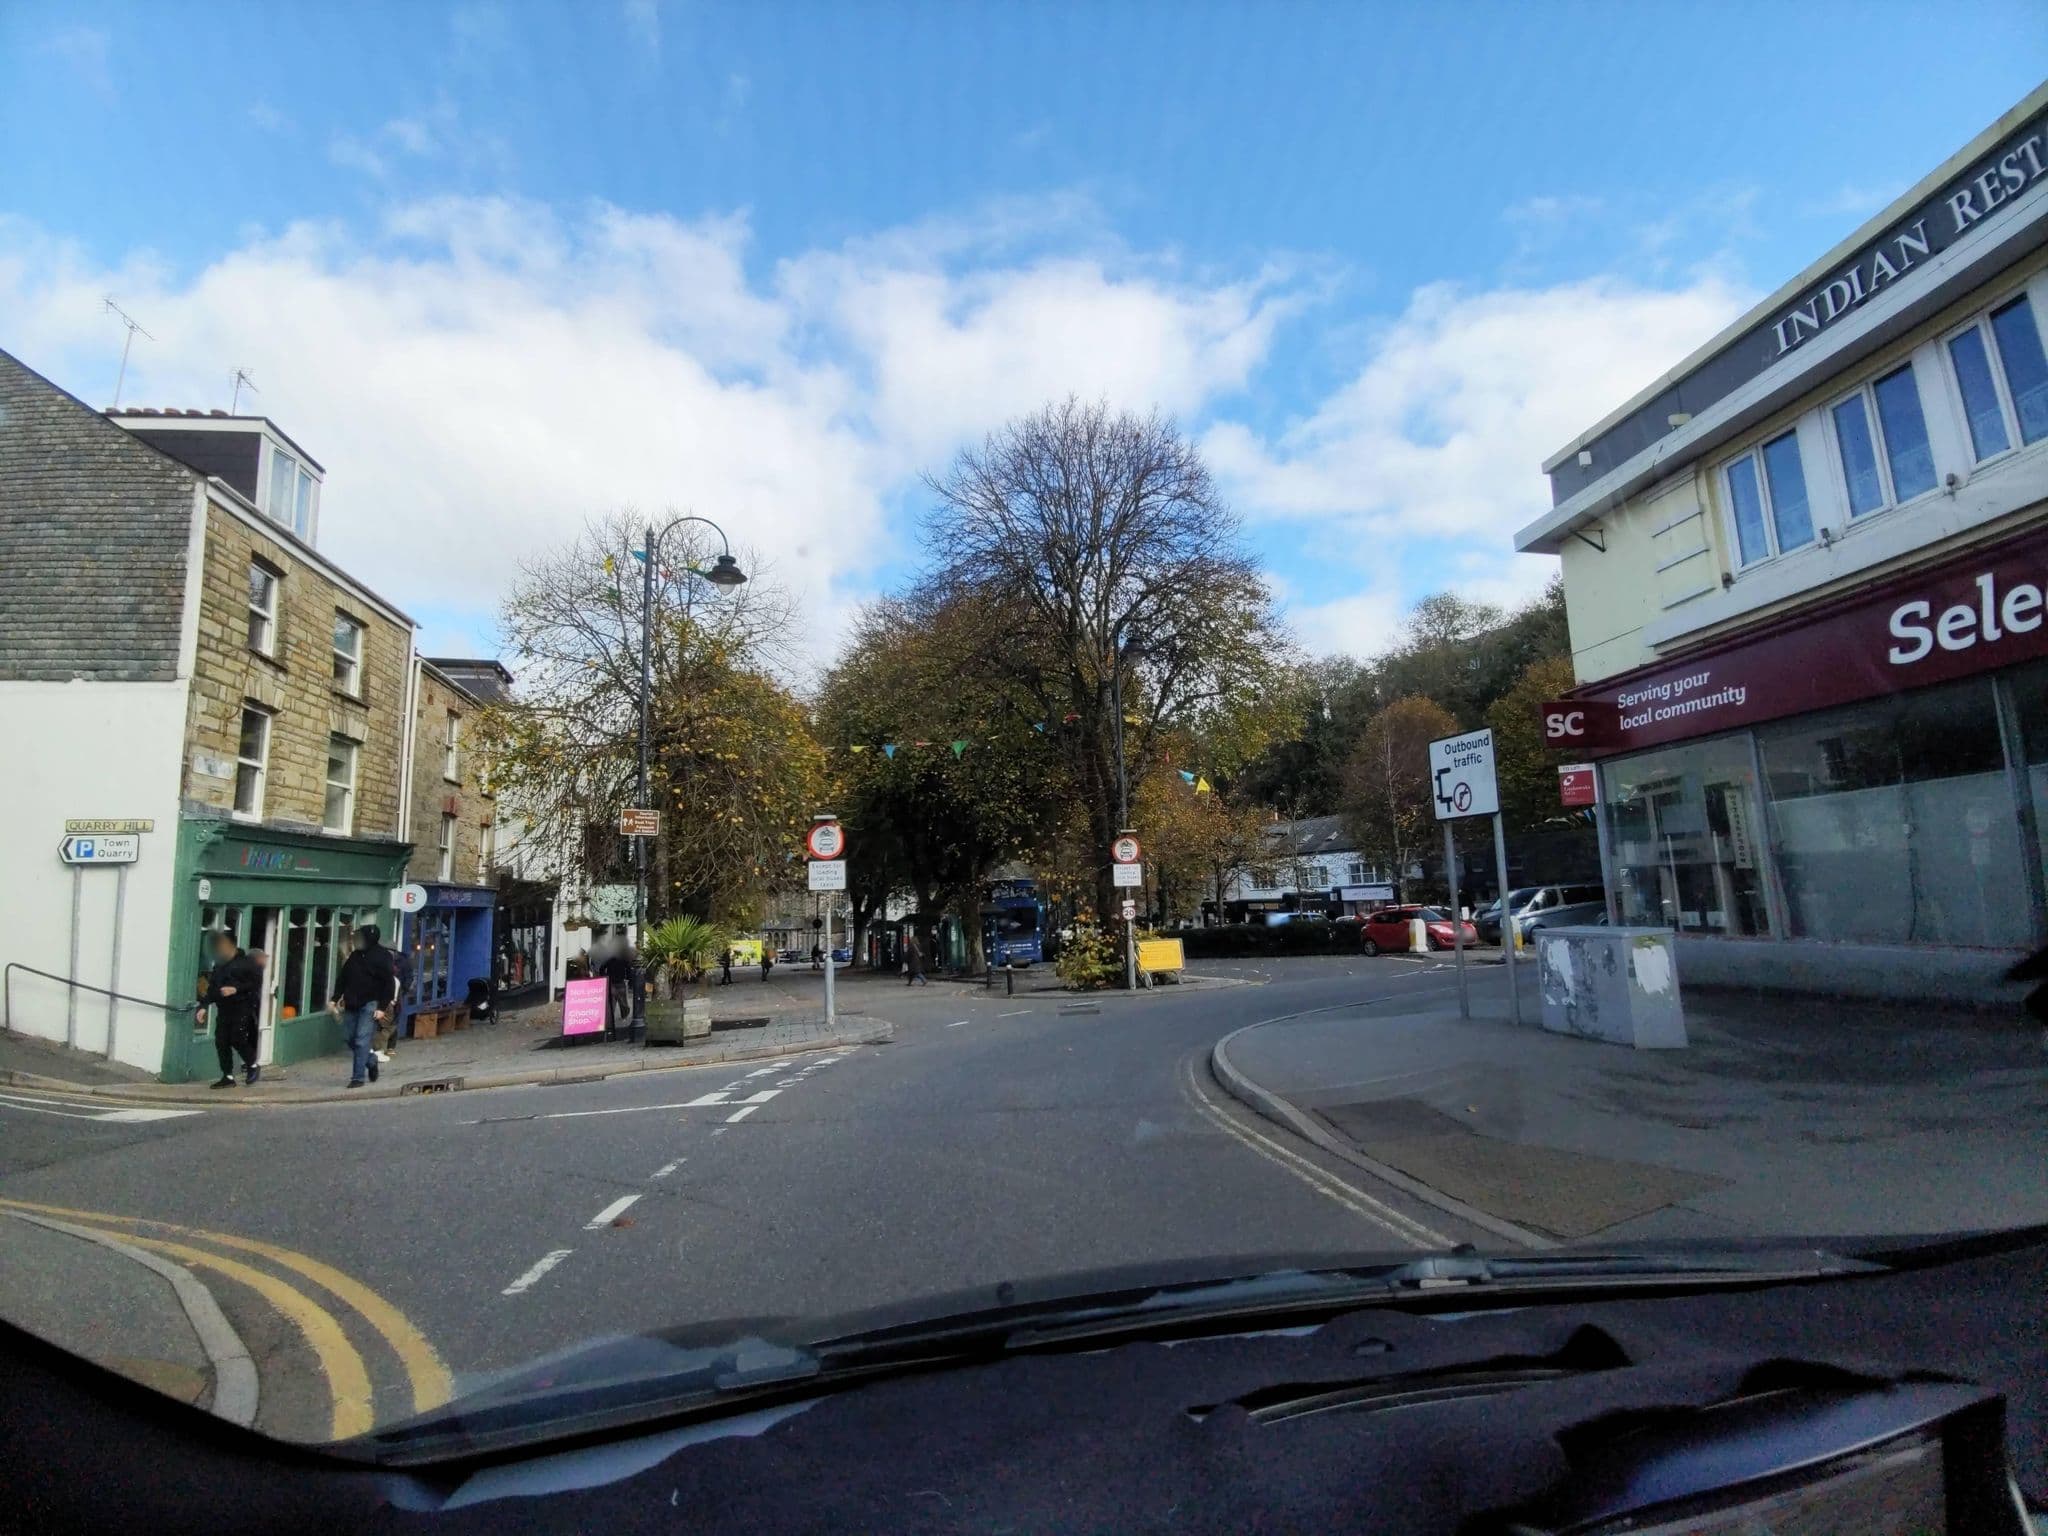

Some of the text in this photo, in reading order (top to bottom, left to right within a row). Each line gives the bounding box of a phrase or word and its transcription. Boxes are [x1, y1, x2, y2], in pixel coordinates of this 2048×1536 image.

[1772, 128, 2048, 355] INDIAN REST
[1889, 572, 2048, 664] Sele
[1617, 671, 1710, 709] Serving your
[1620, 686, 1746, 731] local community
[1546, 711, 1584, 737] SC
[1444, 734, 1490, 755] Outbound
[1454, 753, 1482, 768] traffic
[69, 821, 150, 830] QUARRY HILL
[80, 841, 93, 857] P
[103, 838, 130, 847] Town
[97, 849, 133, 858] Quarry
[405, 892, 417, 904] B
[1124, 909, 1135, 917] 20
